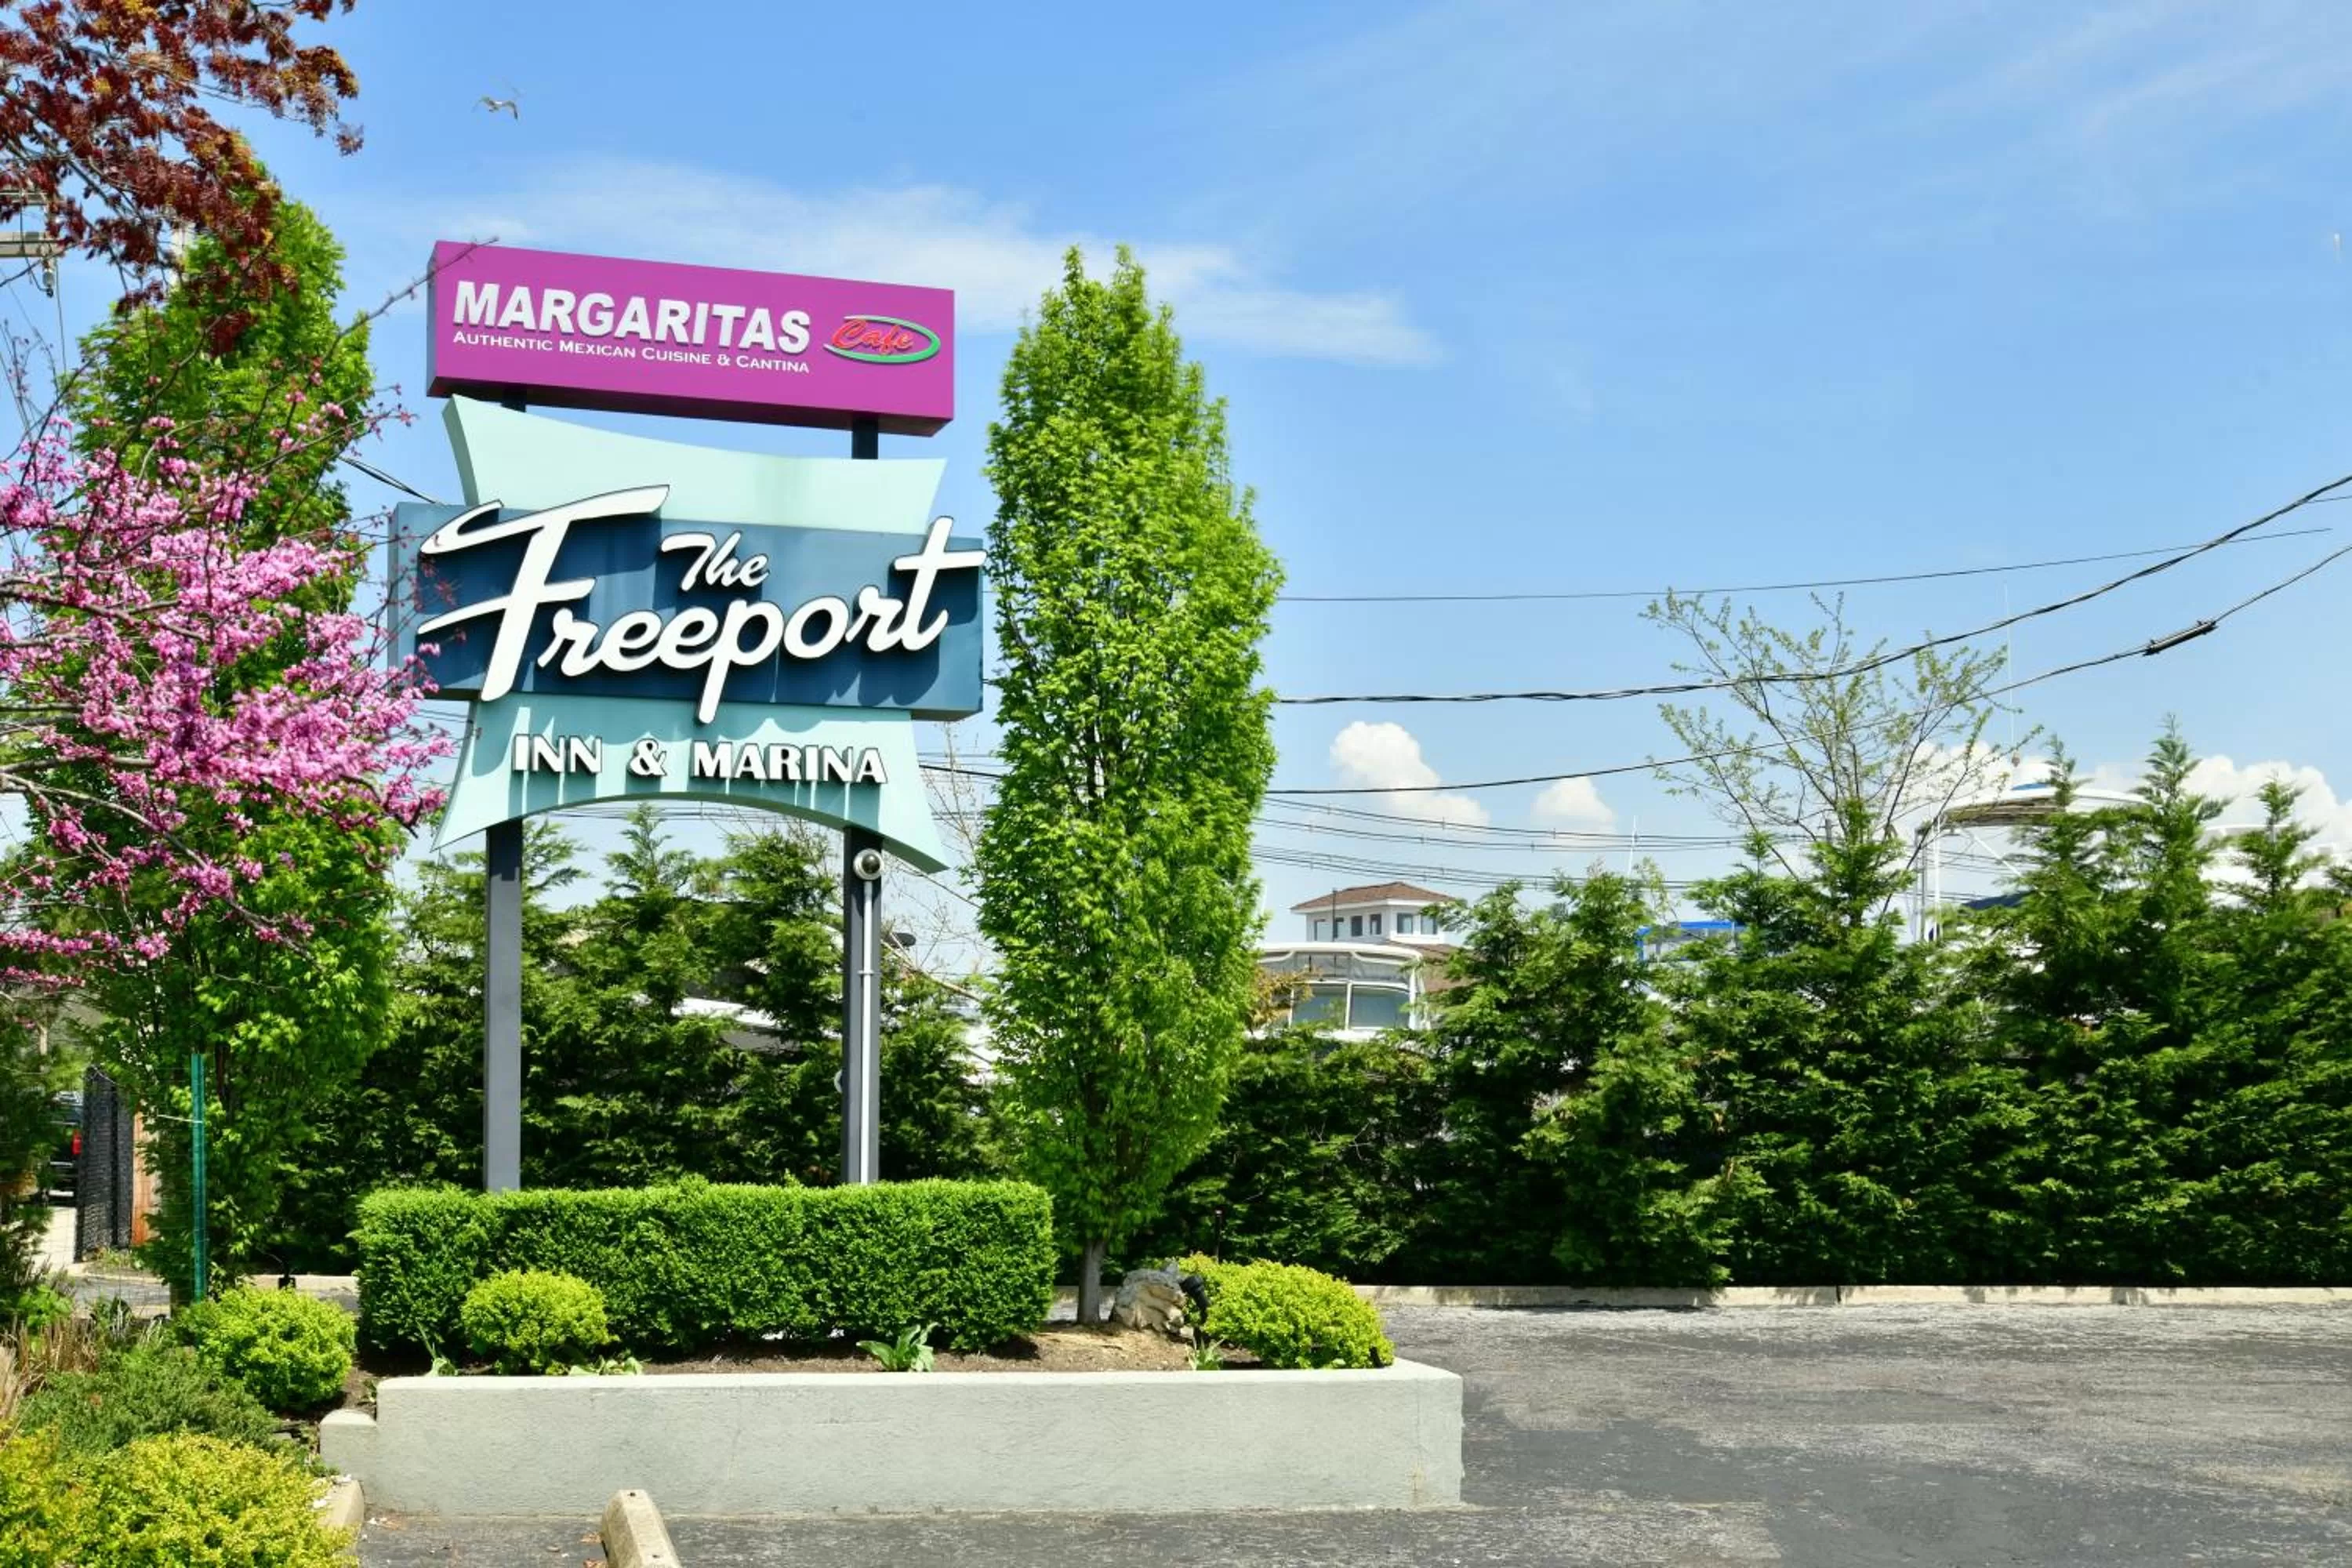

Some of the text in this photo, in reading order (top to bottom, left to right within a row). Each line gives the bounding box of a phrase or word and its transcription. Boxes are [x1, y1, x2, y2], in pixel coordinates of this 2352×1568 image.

[453, 280, 810, 354] MARGARITAS
[453, 330, 810, 374] AUTHENTIC MEXICAN CUISINE & CANTINA
[660, 530, 771, 592] The
[417, 484, 987, 724] Freeport
[512, 734, 888, 784] INN & MARINA
